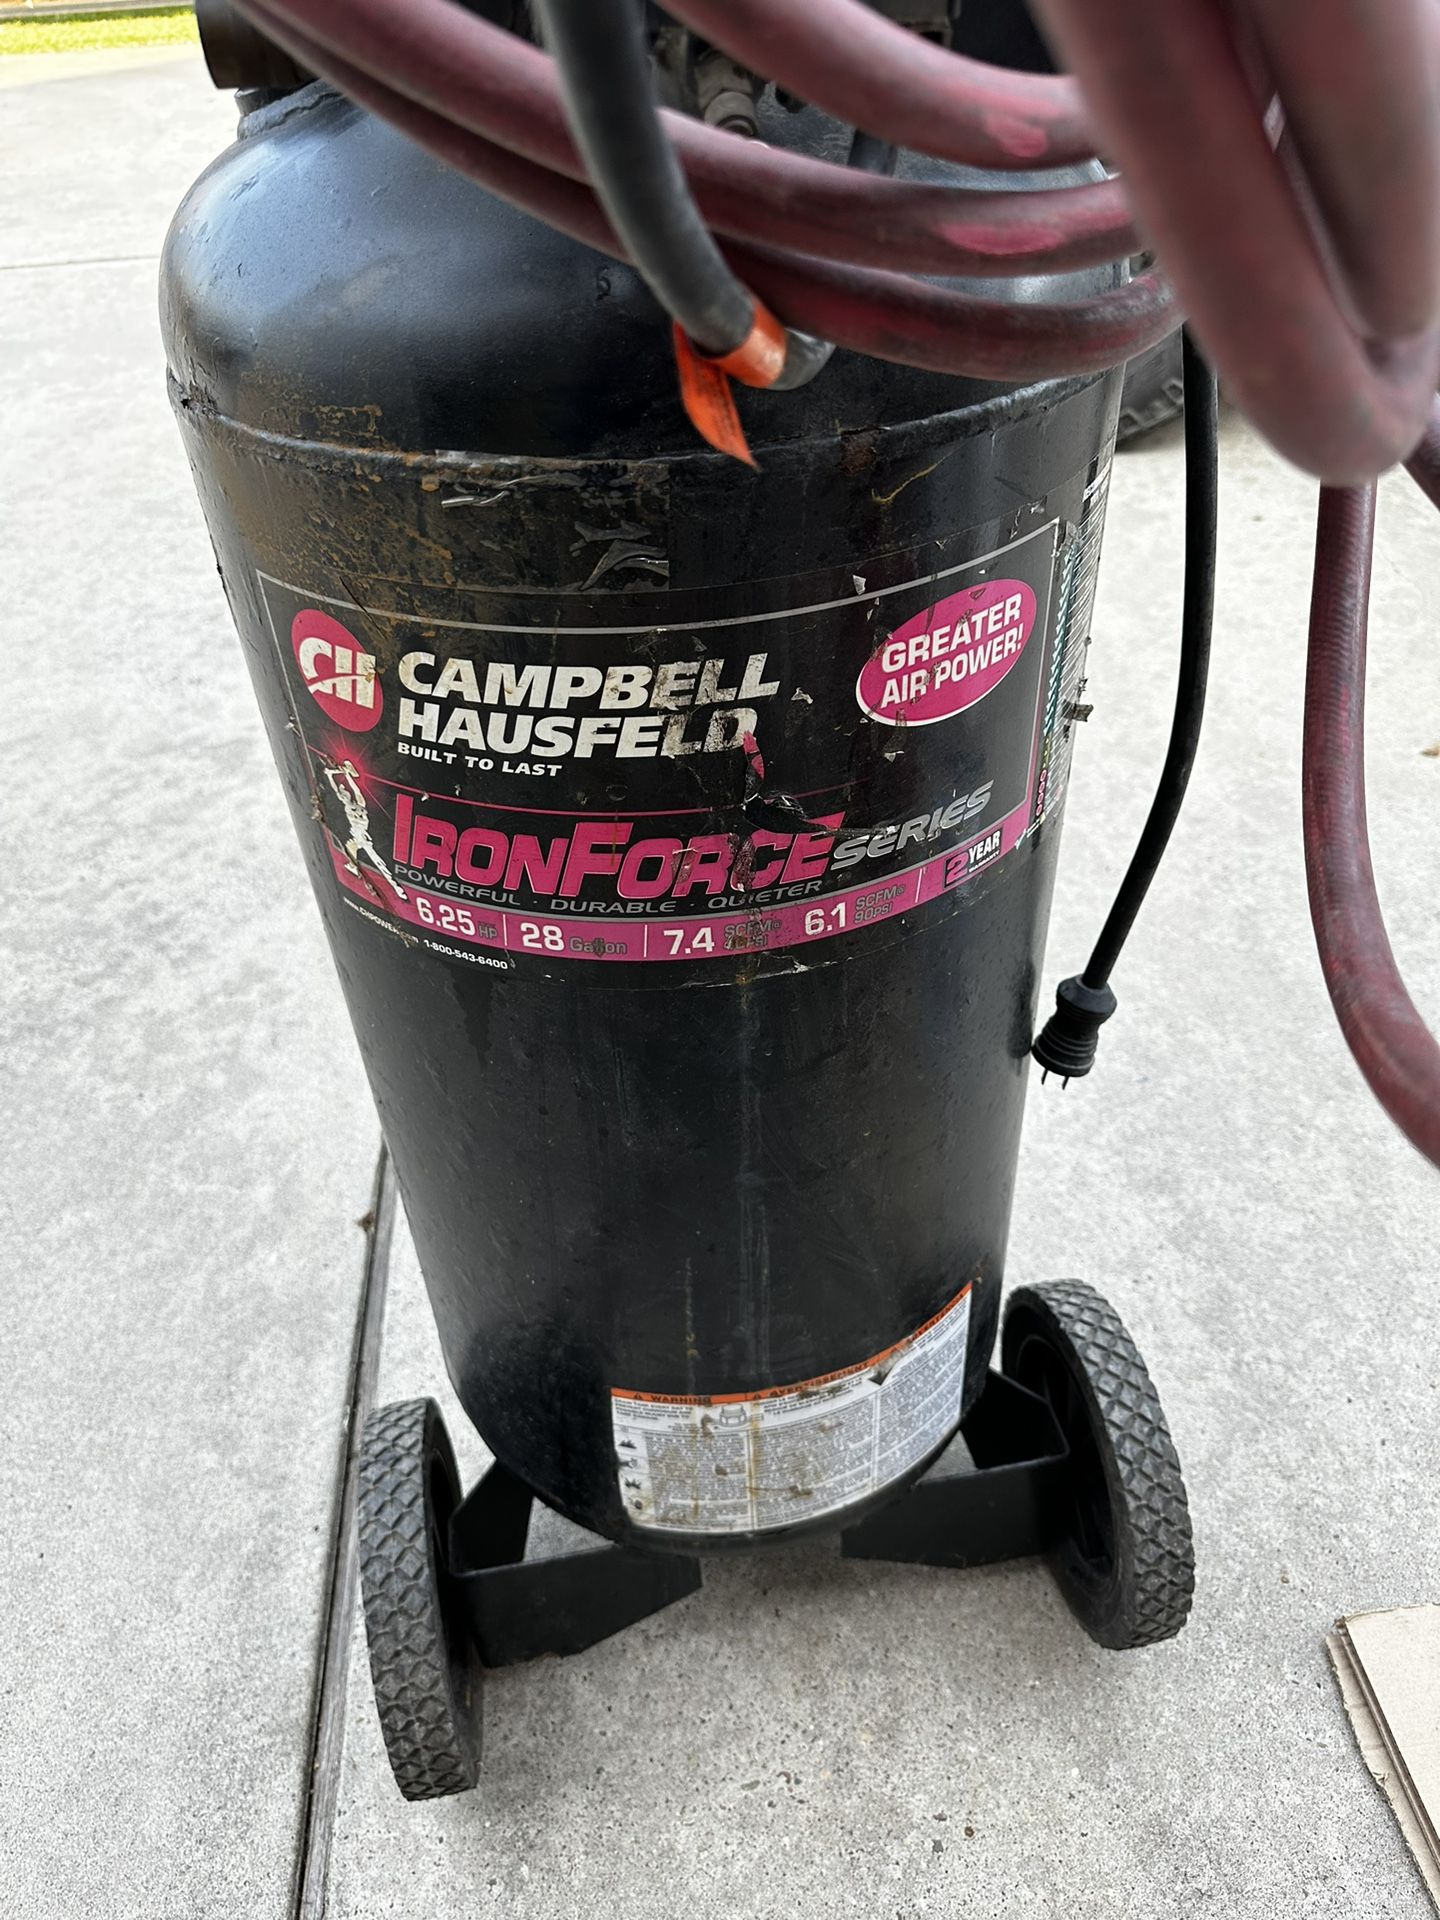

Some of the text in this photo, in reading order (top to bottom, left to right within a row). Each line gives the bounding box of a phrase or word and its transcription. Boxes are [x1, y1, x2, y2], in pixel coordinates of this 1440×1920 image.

[880, 592, 1022, 674] GREATER
[398, 651, 781, 711] CAMPBELL
[880, 622, 1024, 709] AIR POWER!
[398, 697, 759, 760] HAUSFELD
[397, 741, 562, 777] BUILT TO LAST
[830, 779, 995, 871] SERIES
[946, 830, 1001, 885] 2 YEAR
[394, 863, 823, 914] POWERFUL DURABLE QUIETER
[416, 897, 499, 940] 6.25 HP
[520, 922, 565, 952] 28
[663, 927, 716, 956] 7.4
[804, 902, 847, 936] 6.1
[423, 939, 509, 970] 1-800-543-6400
